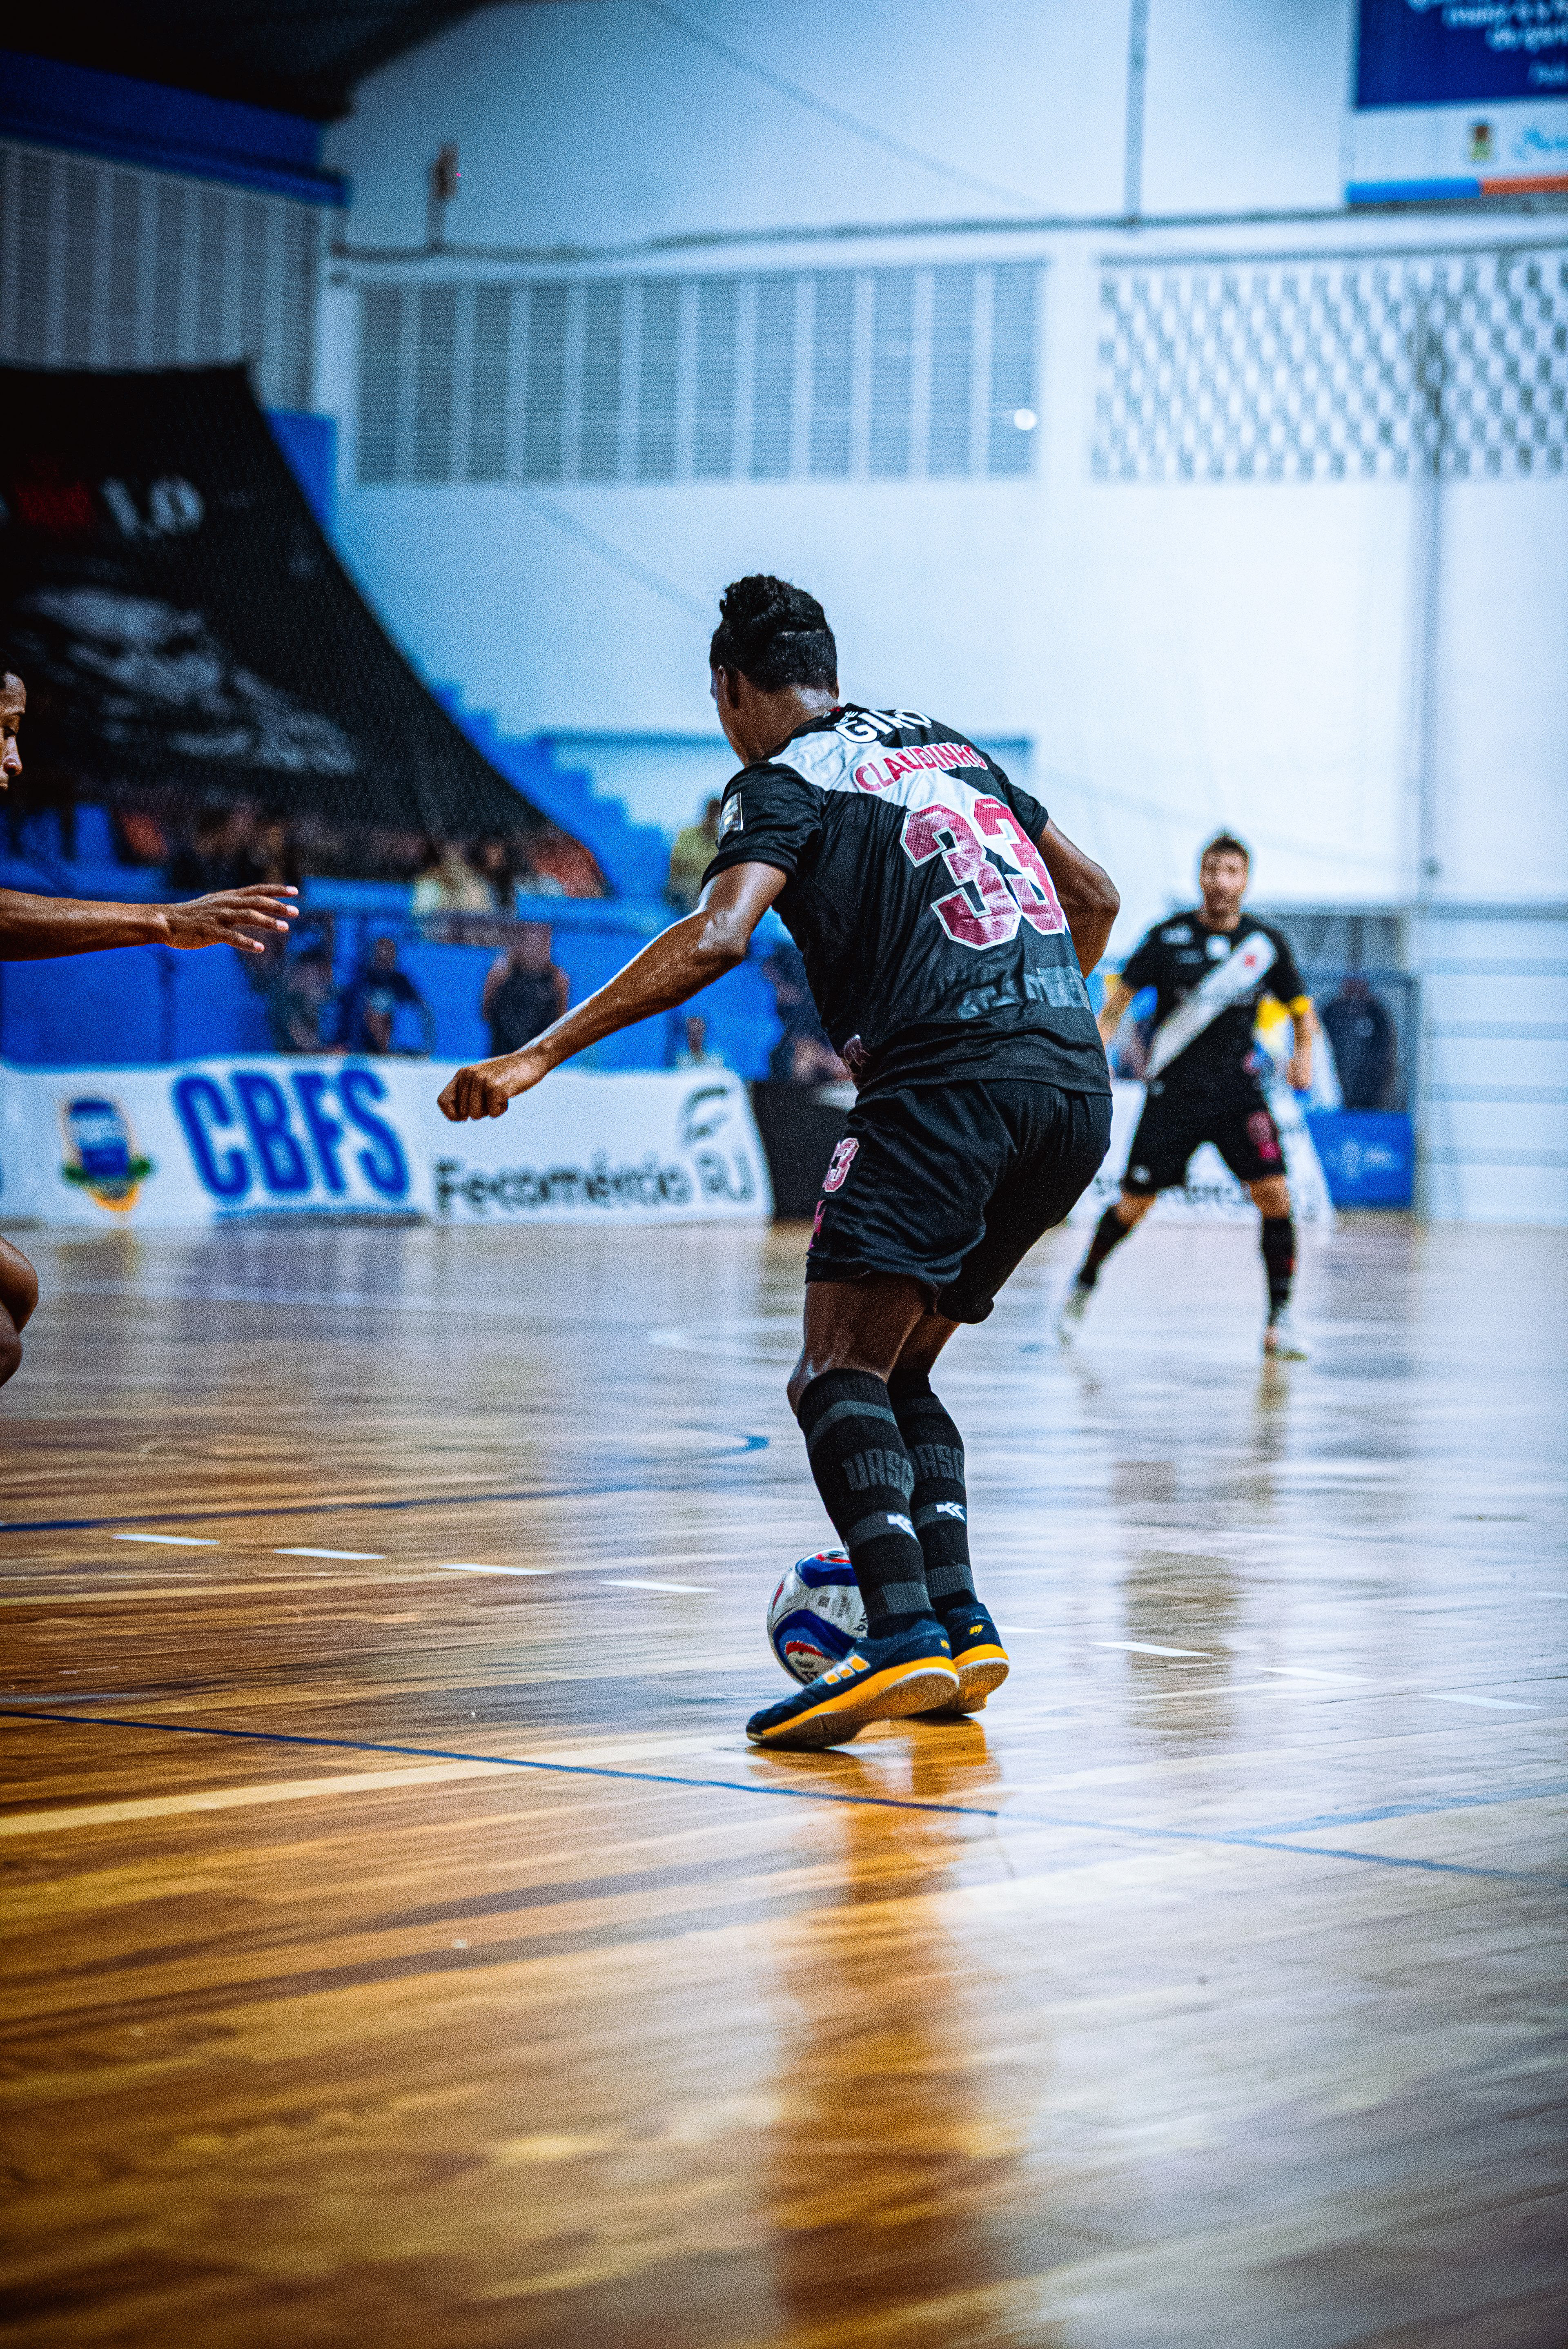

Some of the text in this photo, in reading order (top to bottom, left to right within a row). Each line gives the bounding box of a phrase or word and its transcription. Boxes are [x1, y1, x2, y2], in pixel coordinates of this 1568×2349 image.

[853, 742, 988, 793] CLAUDINHO
[900, 794, 1070, 951] 33
[172, 1067, 408, 1199] CBFS
